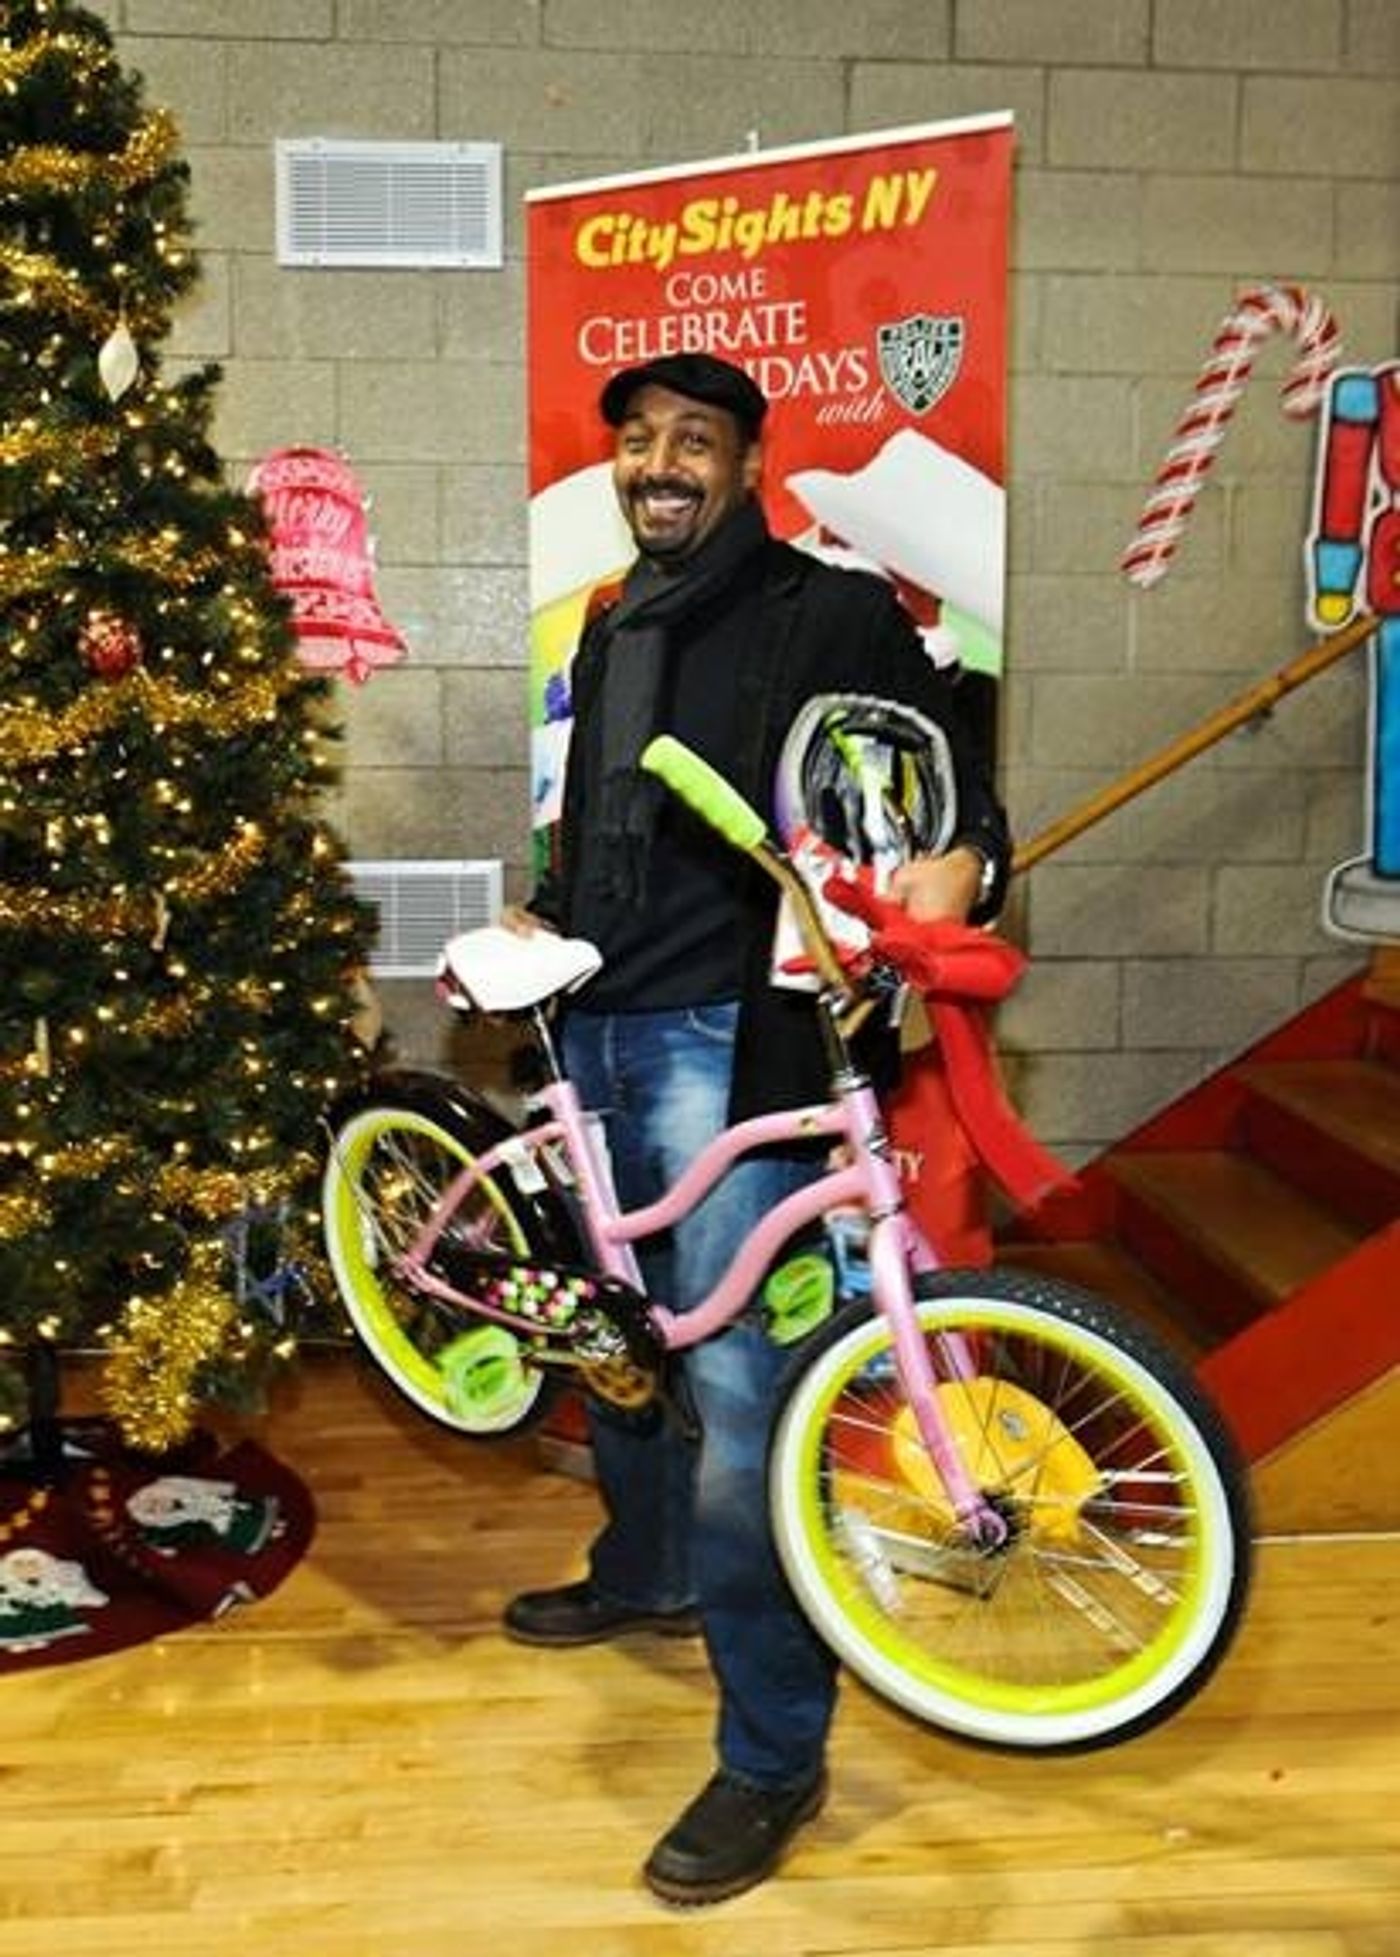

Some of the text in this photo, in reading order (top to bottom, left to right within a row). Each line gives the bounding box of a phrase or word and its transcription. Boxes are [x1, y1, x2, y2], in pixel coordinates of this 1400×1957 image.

[863, 168, 938, 232] NY
[666, 269, 766, 306] COME
[579, 303, 807, 364] CELEBRATE
[815, 386, 887, 426] with
[894, 1151, 926, 1181] TY
